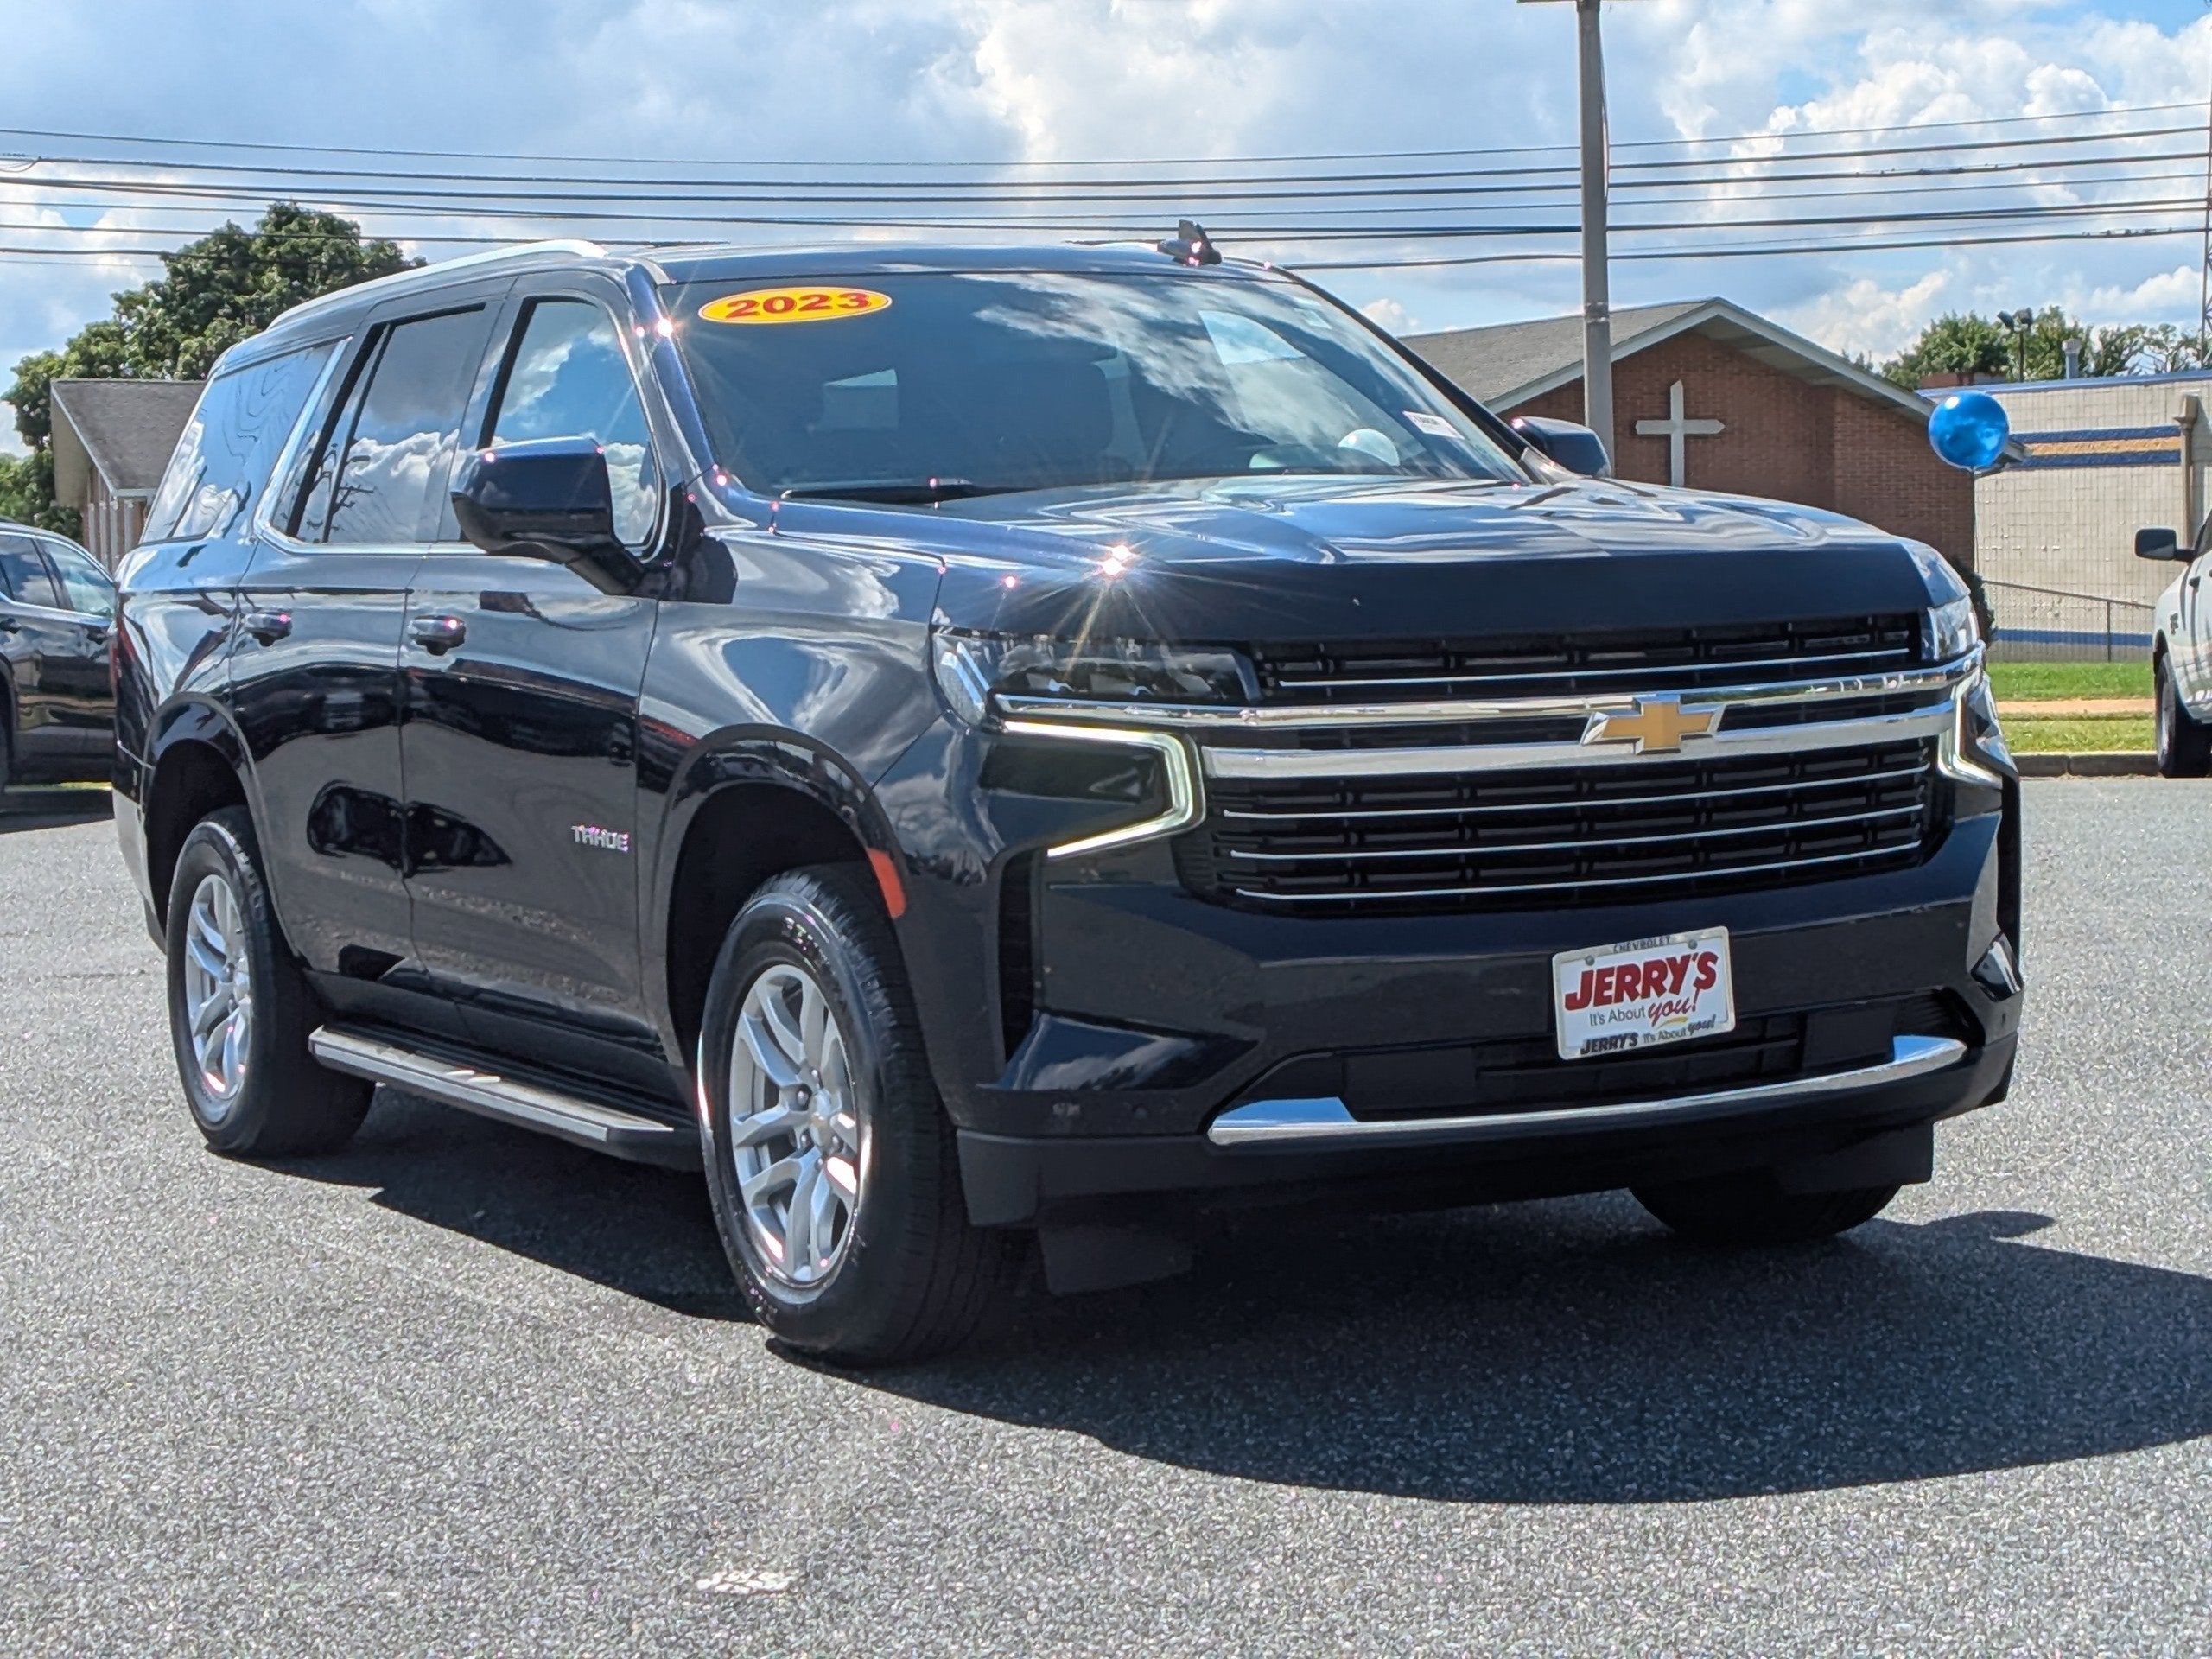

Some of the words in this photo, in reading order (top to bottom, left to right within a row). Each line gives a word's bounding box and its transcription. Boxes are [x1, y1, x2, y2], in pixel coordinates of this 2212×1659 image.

[726, 292, 872, 319] 2023
[570, 825, 630, 852] TAHOE
[1613, 934, 1671, 954] CHEVROLET
[1565, 951, 1719, 1011] JERRY'S
[1589, 1013, 1606, 1027] It's
[1608, 1007, 1646, 1023] About
[1648, 989, 1700, 1028] you!
[1580, 1032, 1639, 1055] JERRY'S
[1658, 1027, 1687, 1040] About
